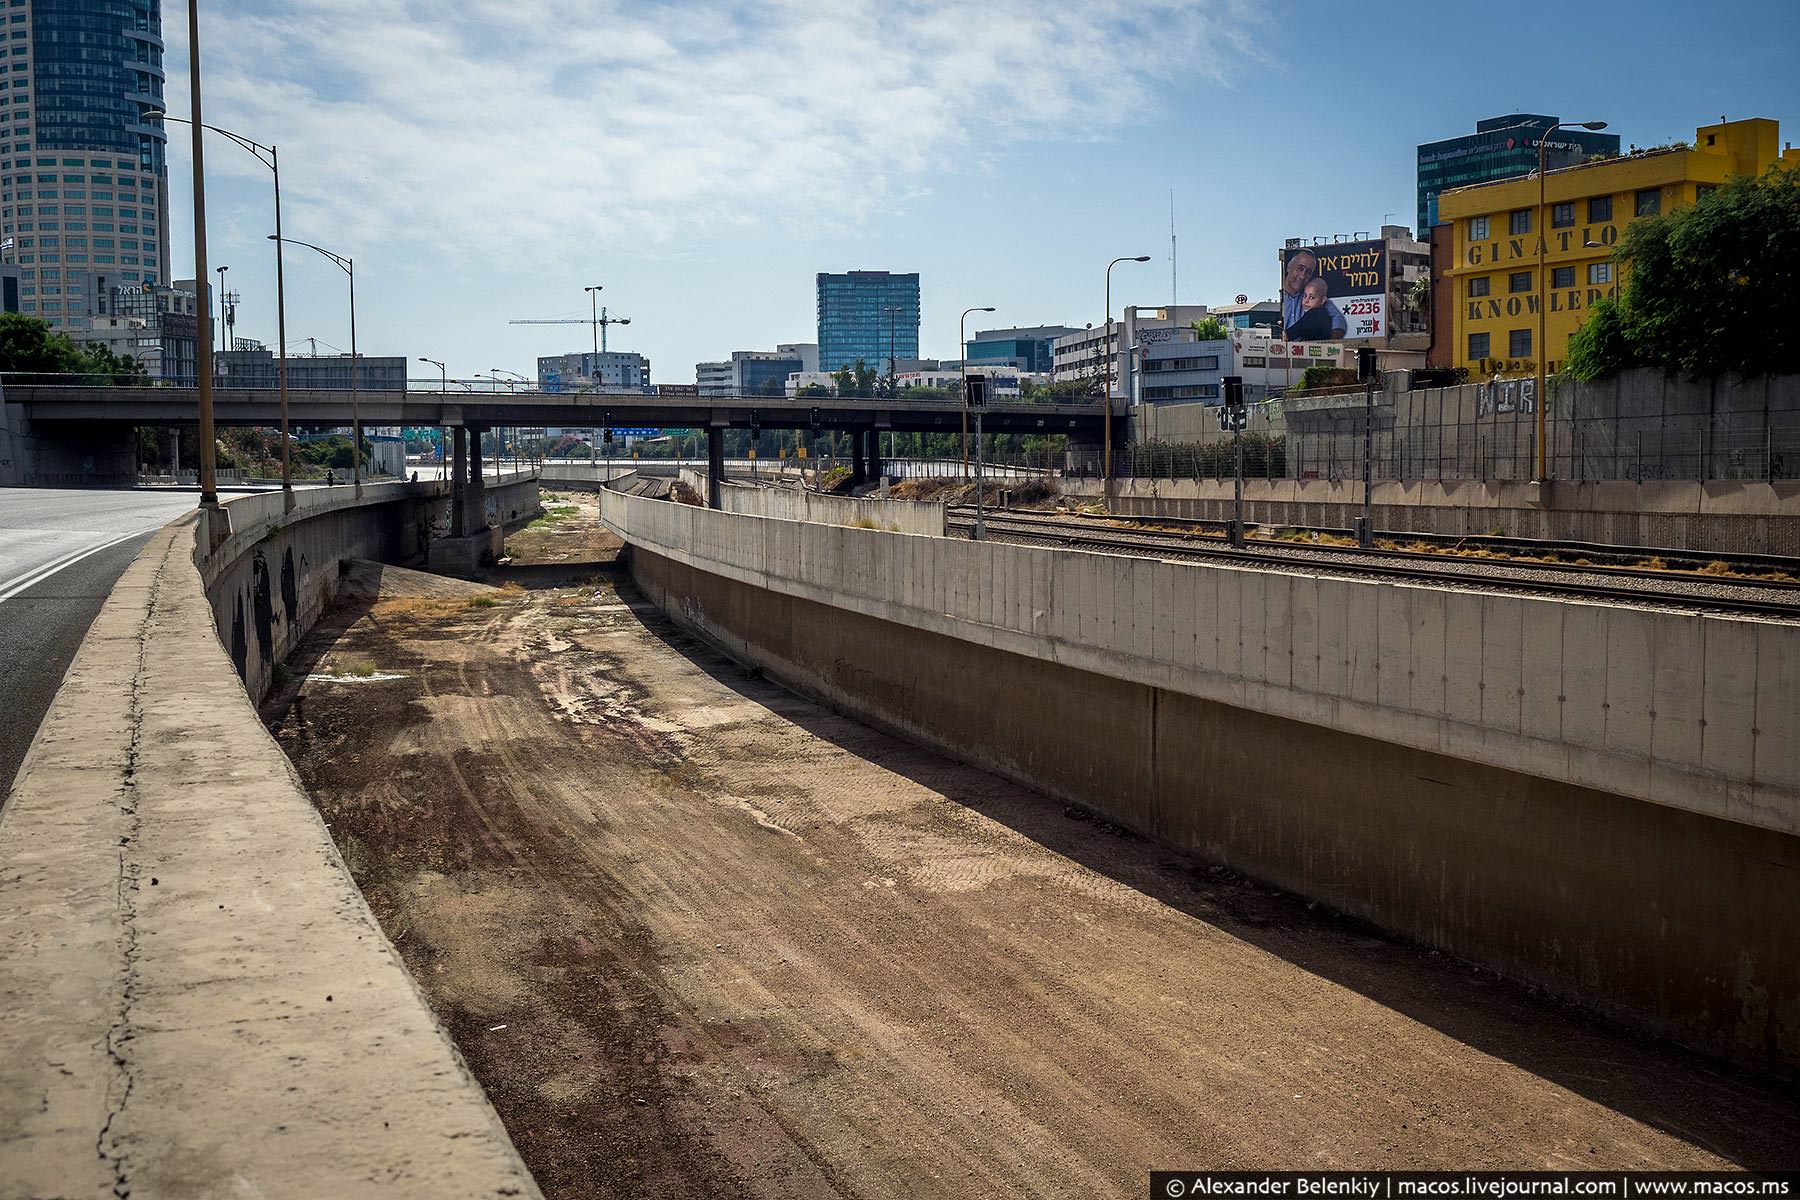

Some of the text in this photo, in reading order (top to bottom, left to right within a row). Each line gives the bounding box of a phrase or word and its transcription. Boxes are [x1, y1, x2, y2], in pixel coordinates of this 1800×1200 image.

[1317, 247, 1380, 277] לחיים אין
[1345, 271, 1379, 288] מחיר
[117, 284, 143, 295] הראל
[1291, 345, 1304, 356] 3M
